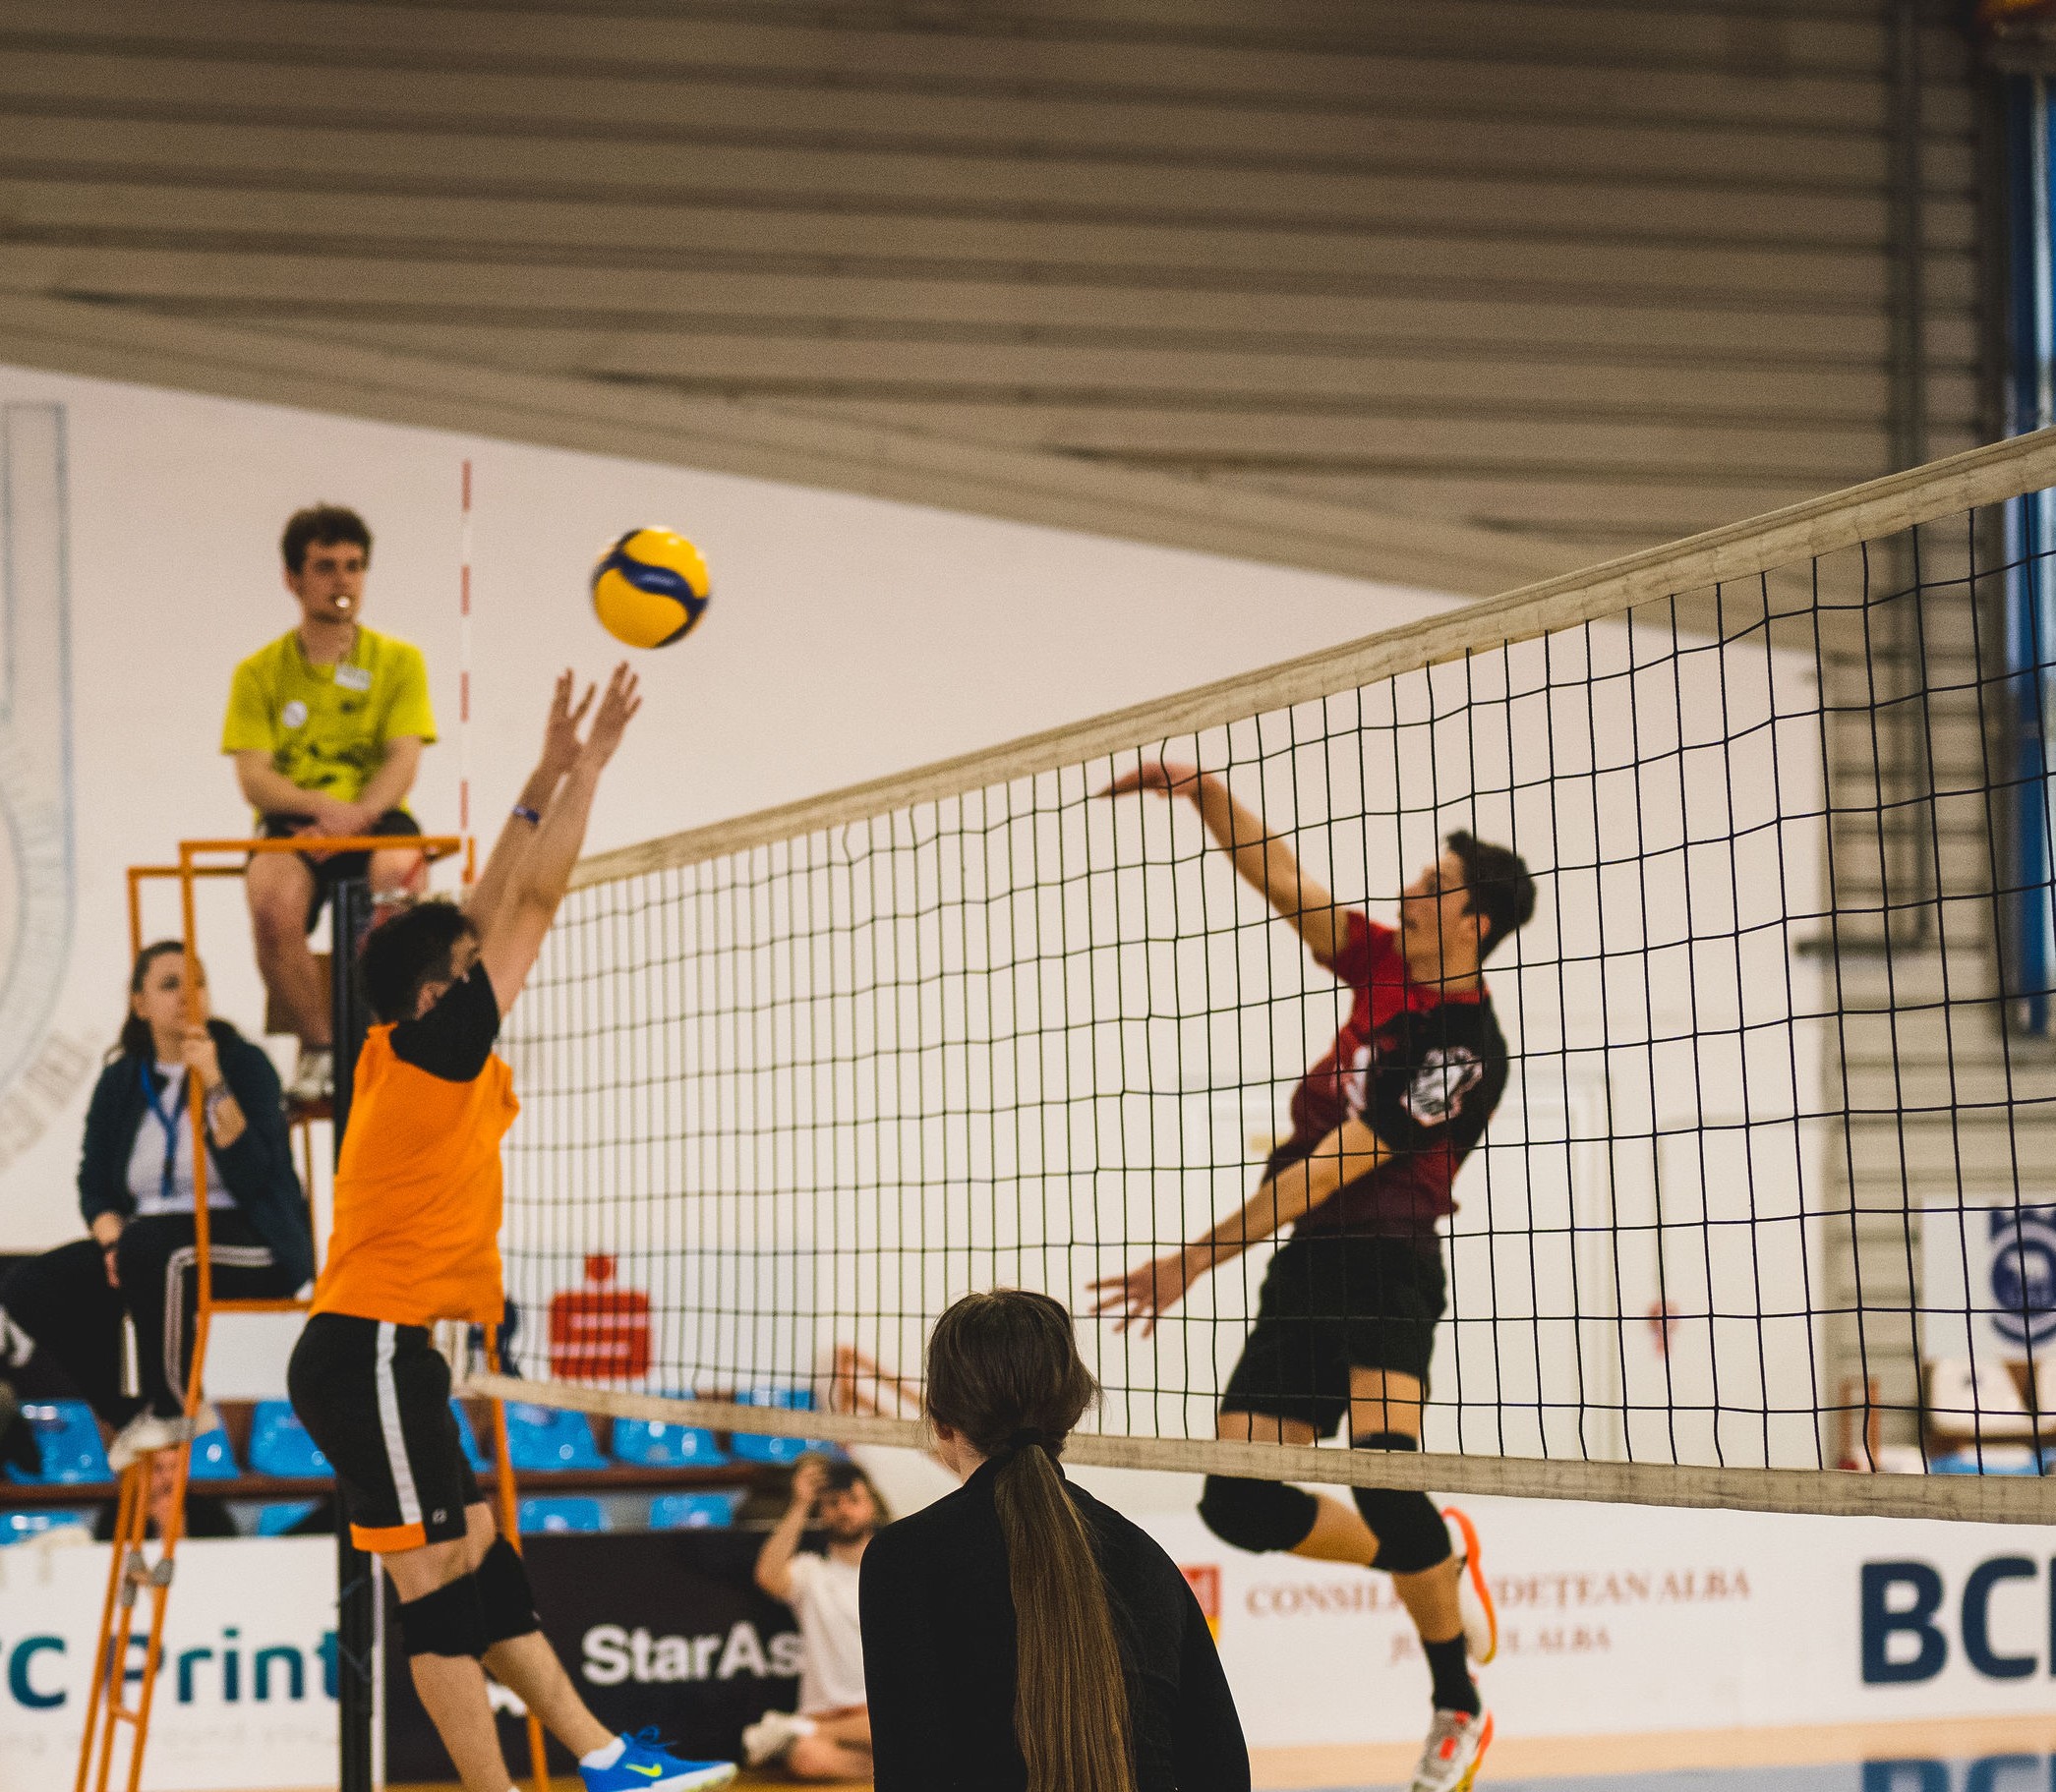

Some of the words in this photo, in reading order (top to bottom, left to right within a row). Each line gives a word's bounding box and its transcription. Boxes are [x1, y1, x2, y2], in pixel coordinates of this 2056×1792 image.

[1245, 1579, 1400, 1619] CONSIL
[1656, 1566, 1751, 1606] ALBA
[1861, 1556, 2056, 1684] BC
